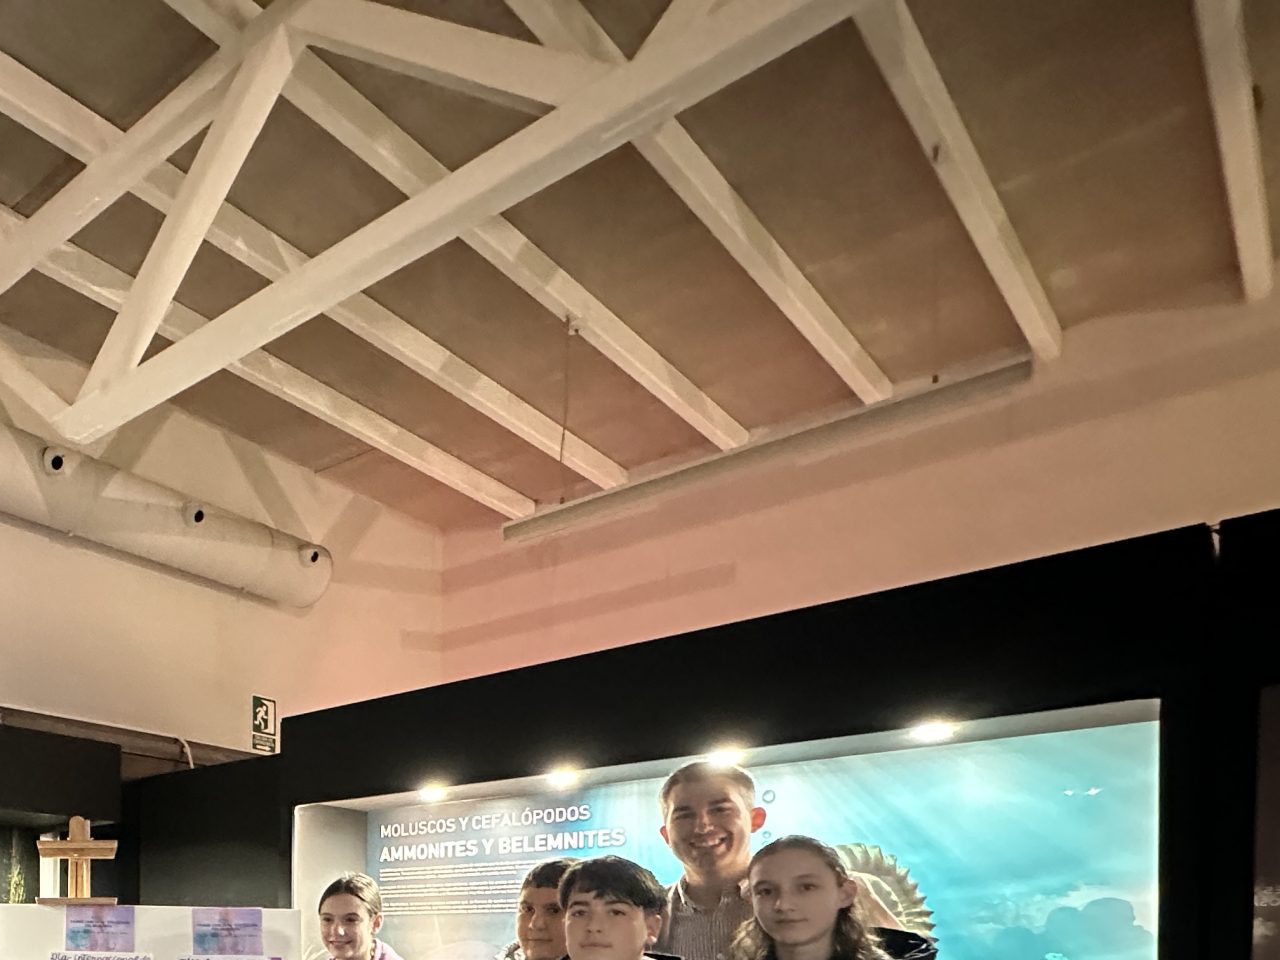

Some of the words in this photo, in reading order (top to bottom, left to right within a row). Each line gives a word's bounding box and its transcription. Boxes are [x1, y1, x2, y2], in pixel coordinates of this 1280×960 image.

[380, 818, 455, 838] MOLUSCOS
[459, 818, 468, 832] Y
[471, 804, 591, 829] CEFALÓPODOS
[379, 840, 478, 862] AMMONITES
[482, 838, 496, 855] Y
[498, 827, 627, 855] BELEMNITES
